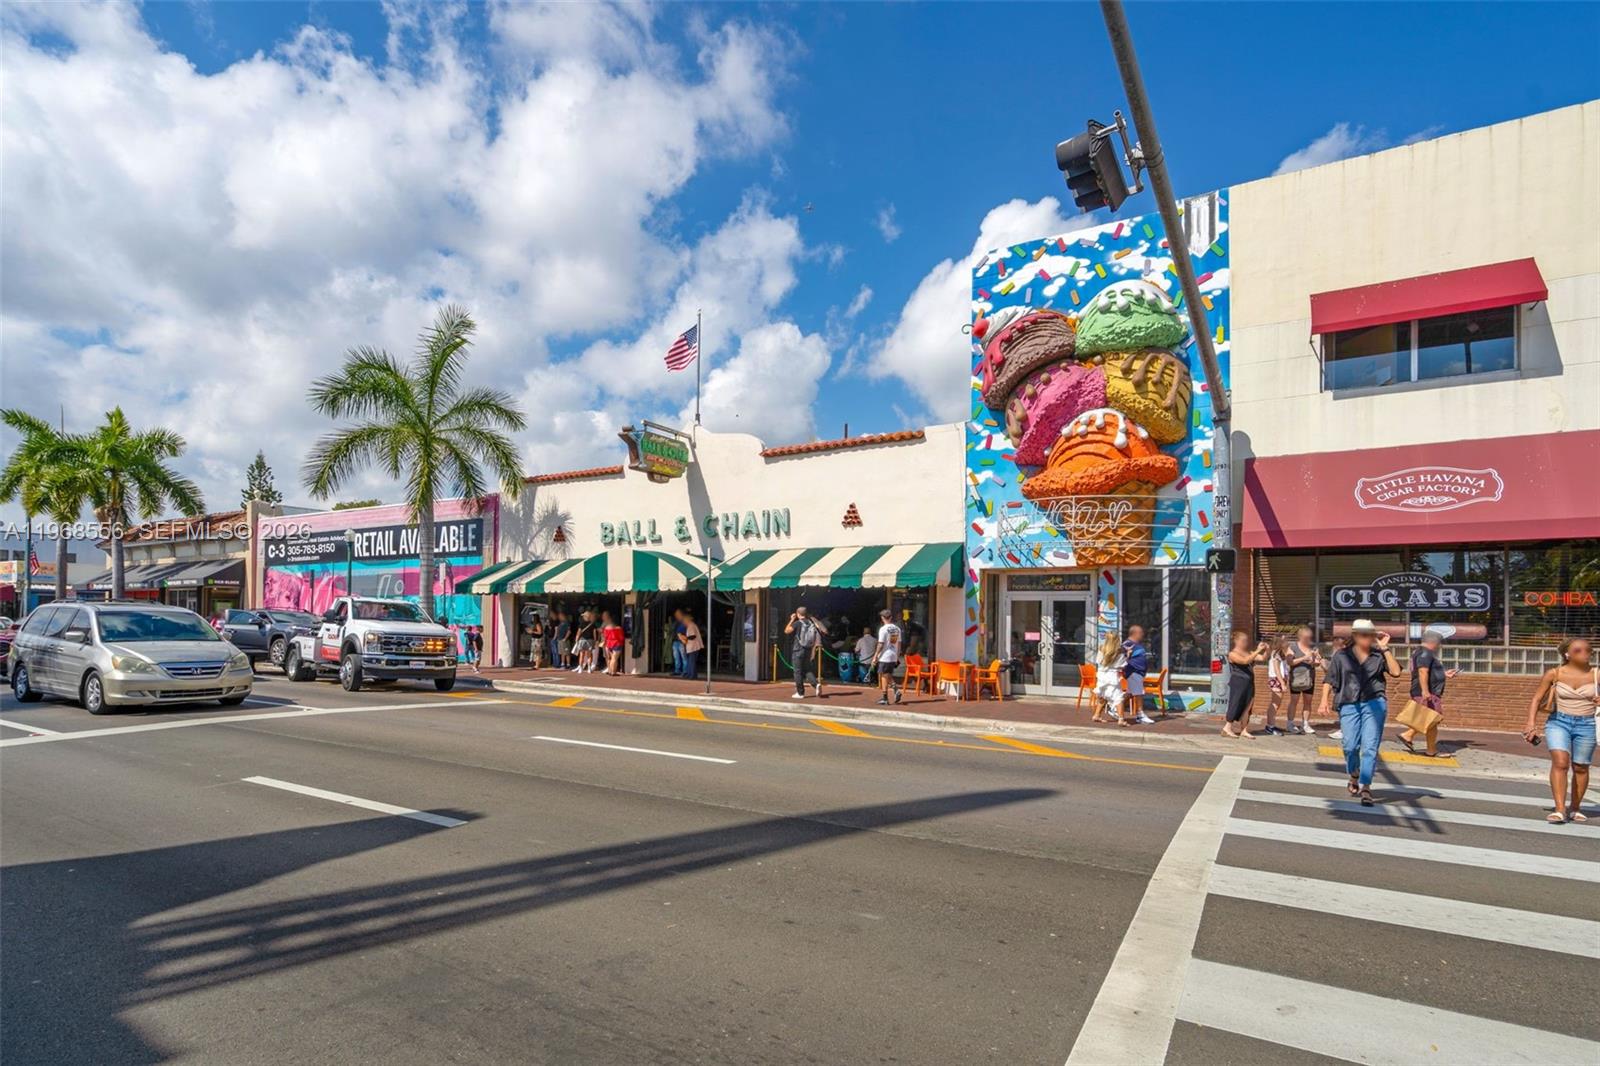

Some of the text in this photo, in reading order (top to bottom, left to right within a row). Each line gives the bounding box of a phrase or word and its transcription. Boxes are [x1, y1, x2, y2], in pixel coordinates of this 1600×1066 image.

[1367, 474, 1486, 495] LITTLE HAVANA
[1376, 484, 1480, 502] CIGAR FACTORY
[600, 507, 791, 545] BALL & CHAIN
[287, 543, 336, 556] 305-763-8150
[354, 523, 477, 557] RETAIL AVLABLE
[1378, 575, 1438, 587] HANDMADE
[1335, 588, 1485, 608] CIGARS
[1524, 591, 1598, 606] COHIBA
